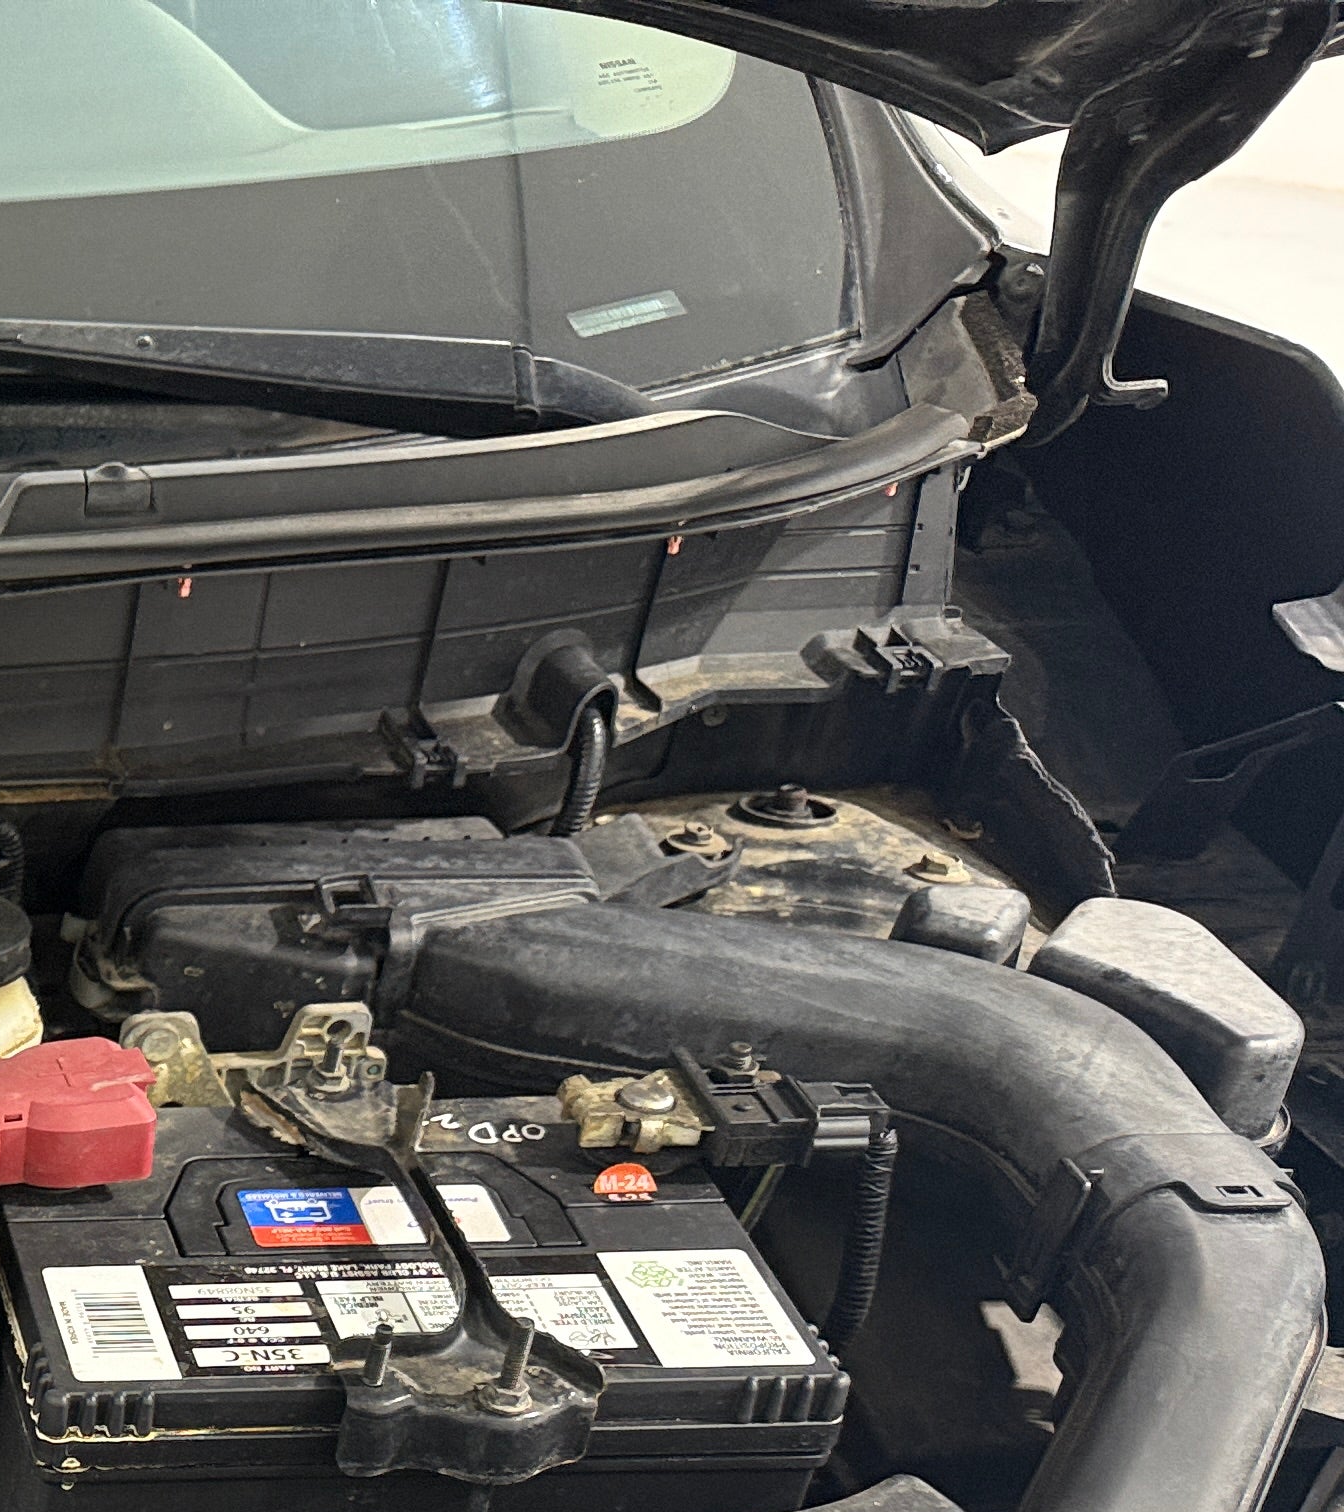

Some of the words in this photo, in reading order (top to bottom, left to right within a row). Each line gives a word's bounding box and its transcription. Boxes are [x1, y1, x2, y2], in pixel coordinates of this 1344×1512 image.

[601, 1174, 649, 1191] M-24
[232, 1306, 256, 1315] 95
[234, 1326, 269, 1335] 640
[222, 1349, 304, 1362] 35N-C
